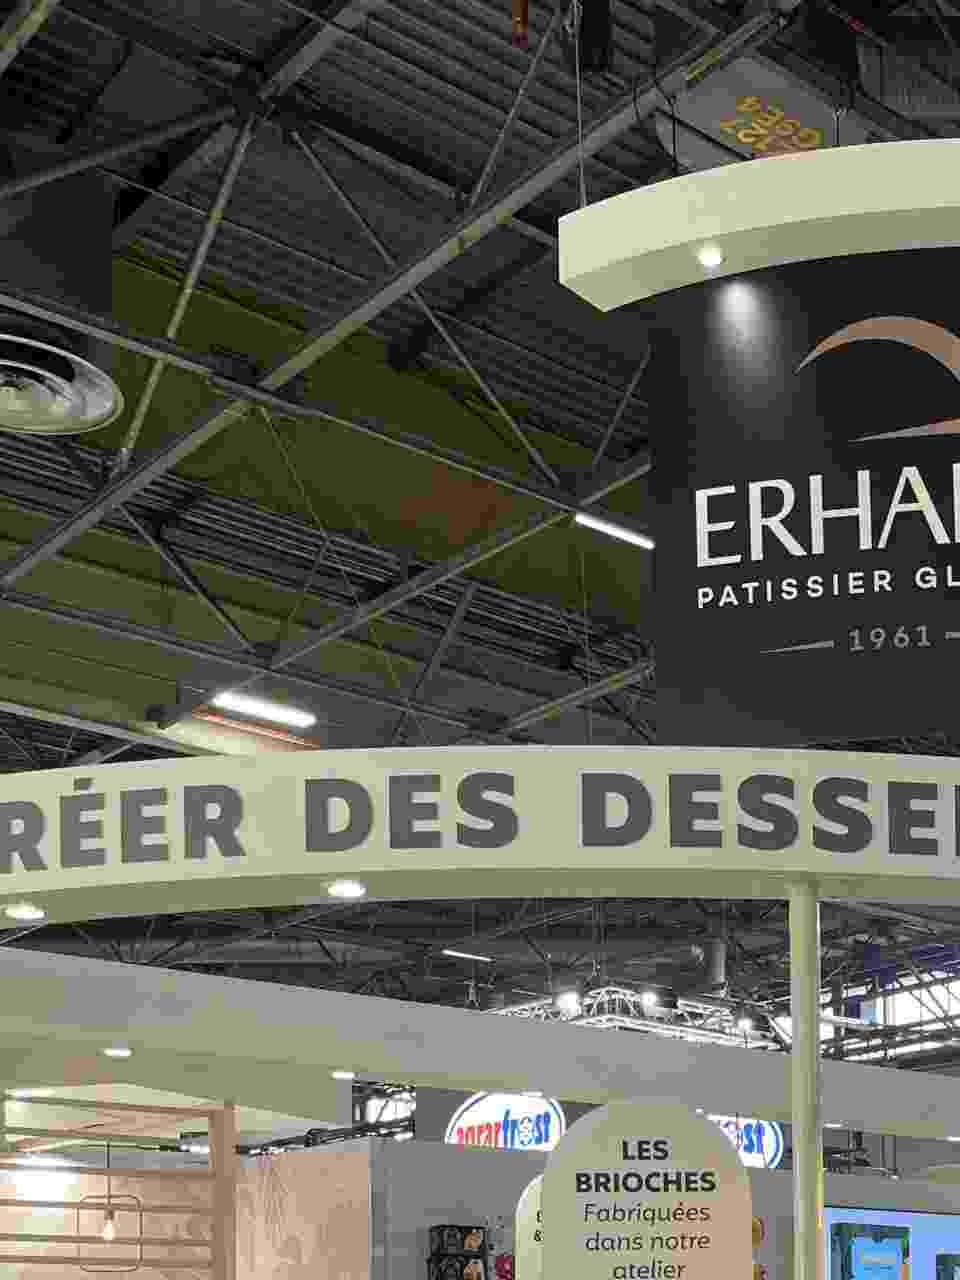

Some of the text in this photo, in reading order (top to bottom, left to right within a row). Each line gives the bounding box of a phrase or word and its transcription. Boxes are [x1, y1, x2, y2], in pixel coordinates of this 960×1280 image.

[697, 569, 893, 609] PATISSIER
[848, 624, 931, 652] 1961
[304, 771, 520, 853] DES
[622, 1140, 669, 1161] LES
[576, 1172, 716, 1193] BRIOCHES
[584, 1202, 711, 1226] Fabriquées
[585, 1232, 711, 1251] dans notre
[612, 1259, 686, 1280] atelier
